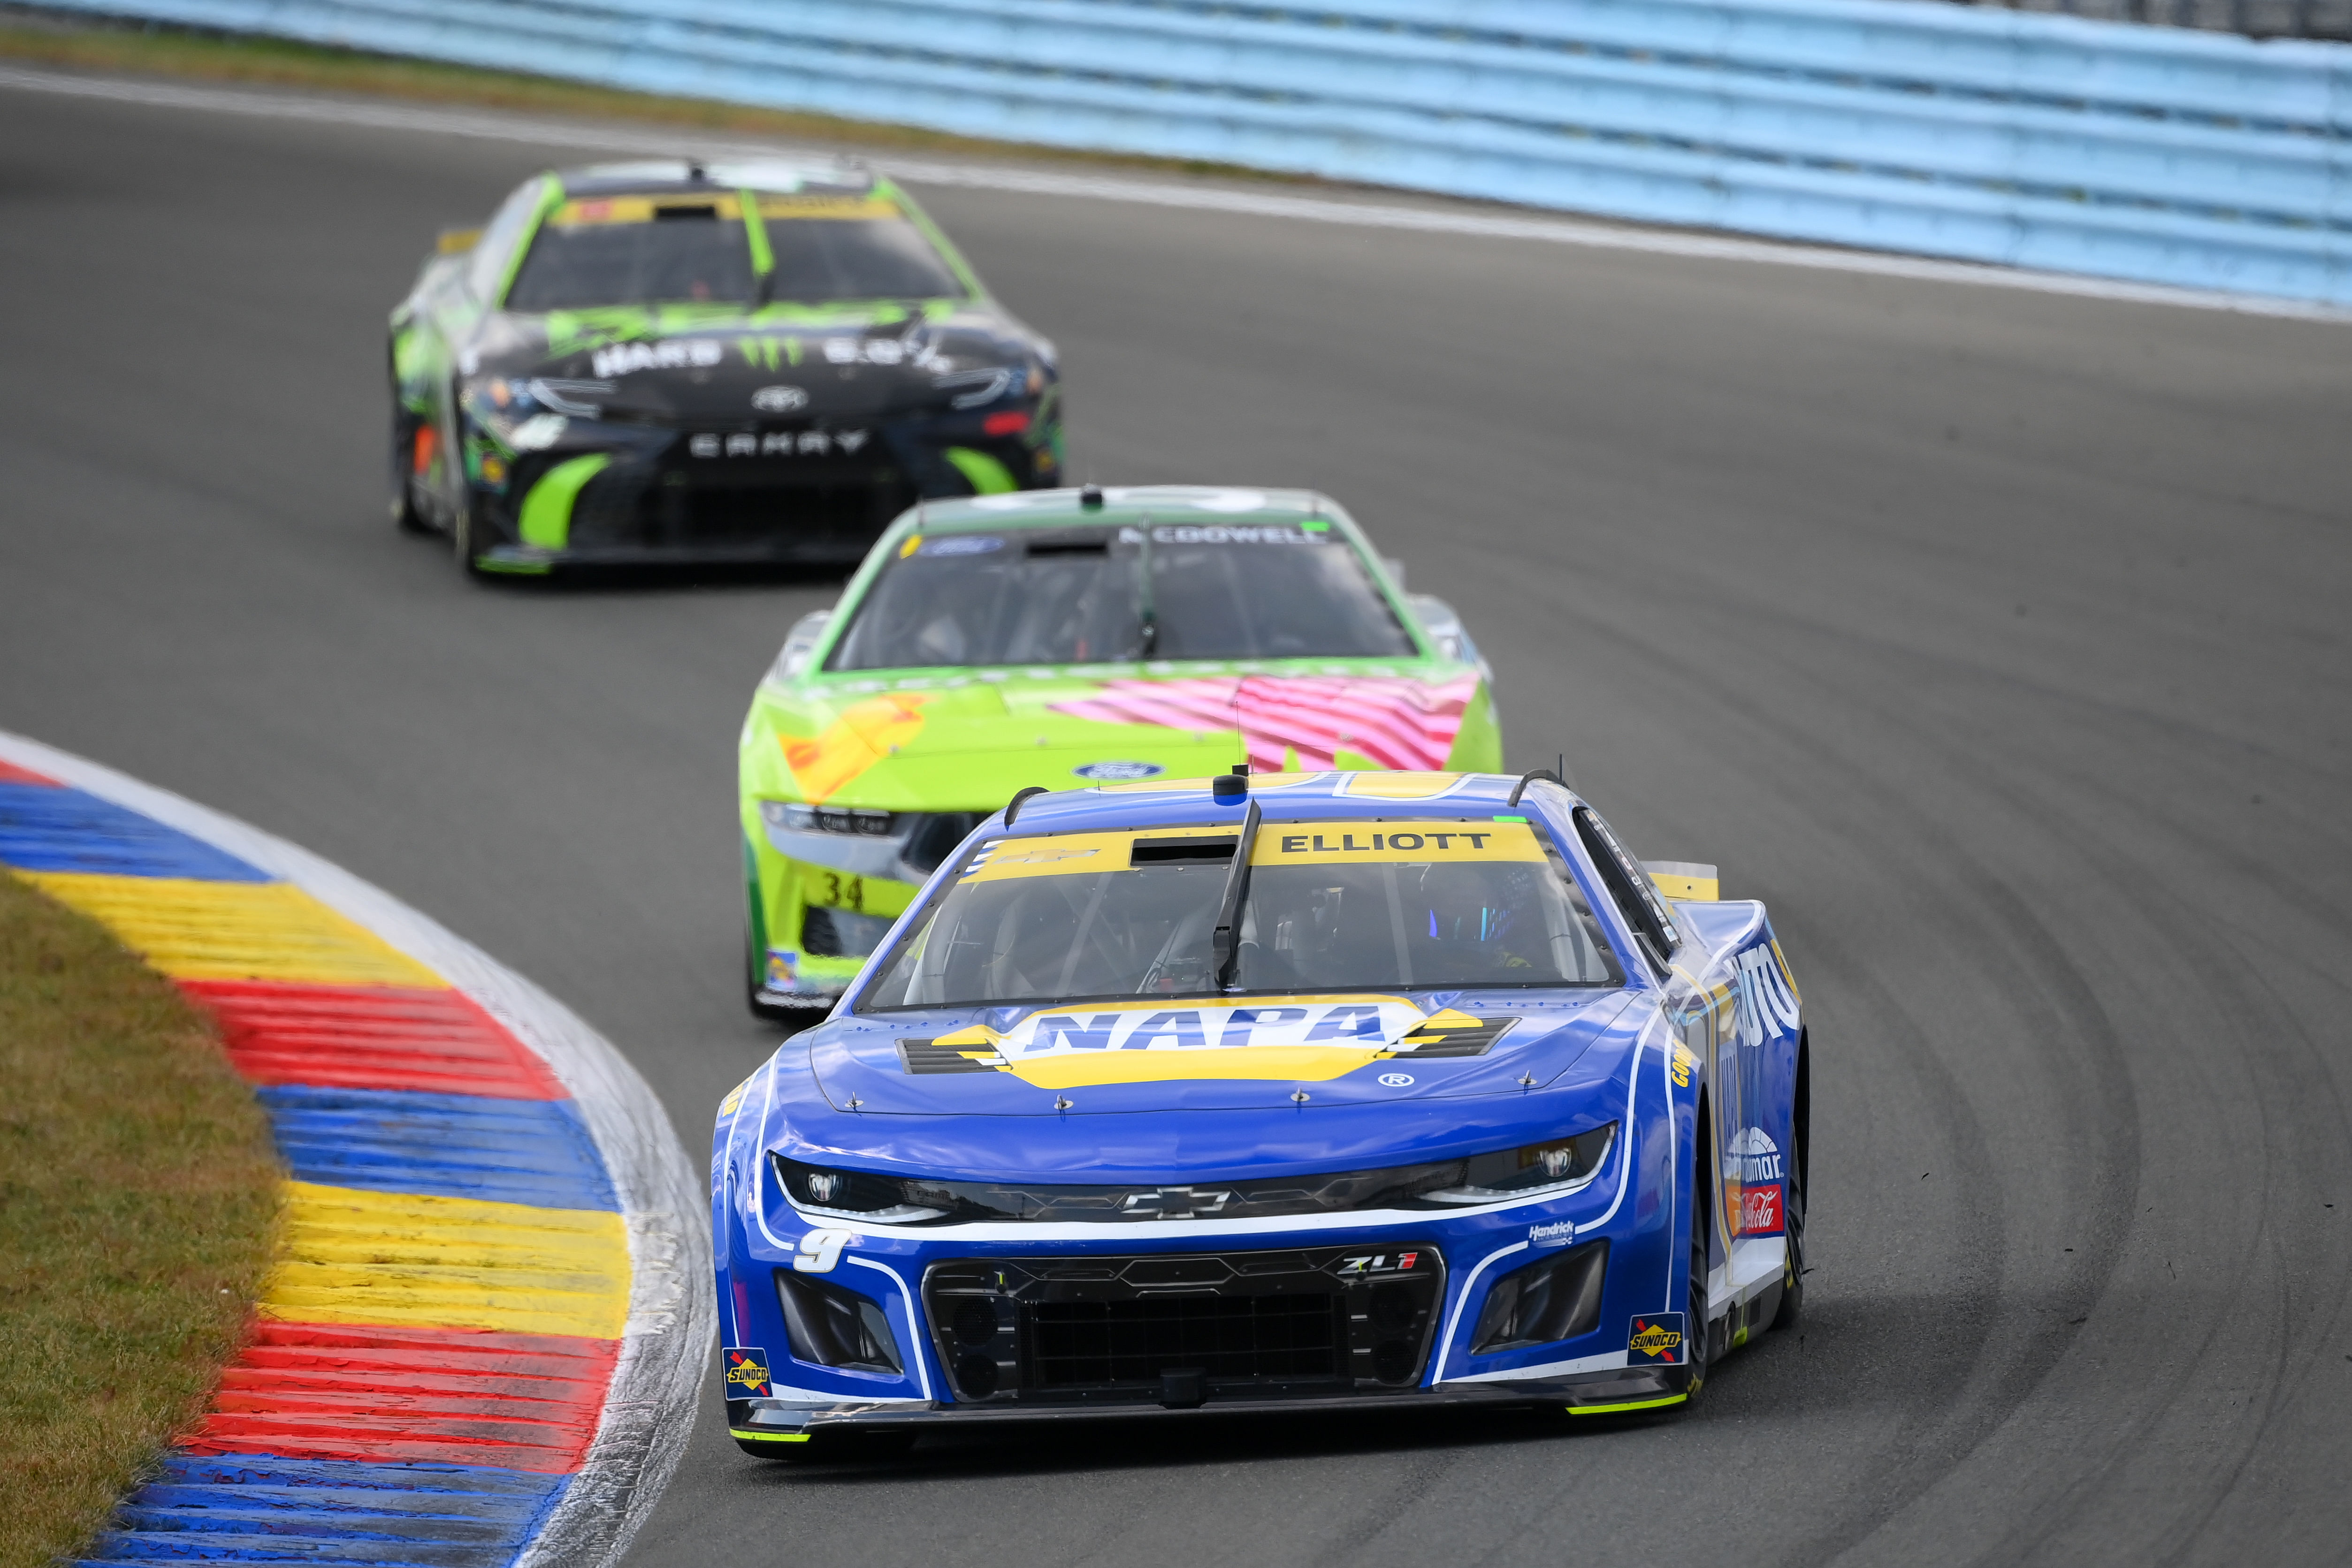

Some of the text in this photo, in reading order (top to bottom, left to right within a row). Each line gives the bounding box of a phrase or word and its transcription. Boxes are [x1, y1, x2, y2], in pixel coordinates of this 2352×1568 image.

[1281, 833, 1491, 853] ELLIOTT
[822, 872, 864, 911] 34
[1023, 1005, 1387, 1051] NAPA
[1528, 1220, 1574, 1242] Hendrick
[793, 1228, 852, 1273] 9
[1337, 1252, 1418, 1275] ZL1
[1632, 1333, 1679, 1348] SUNOCO
[729, 1368, 767, 1381] SUNOCO
